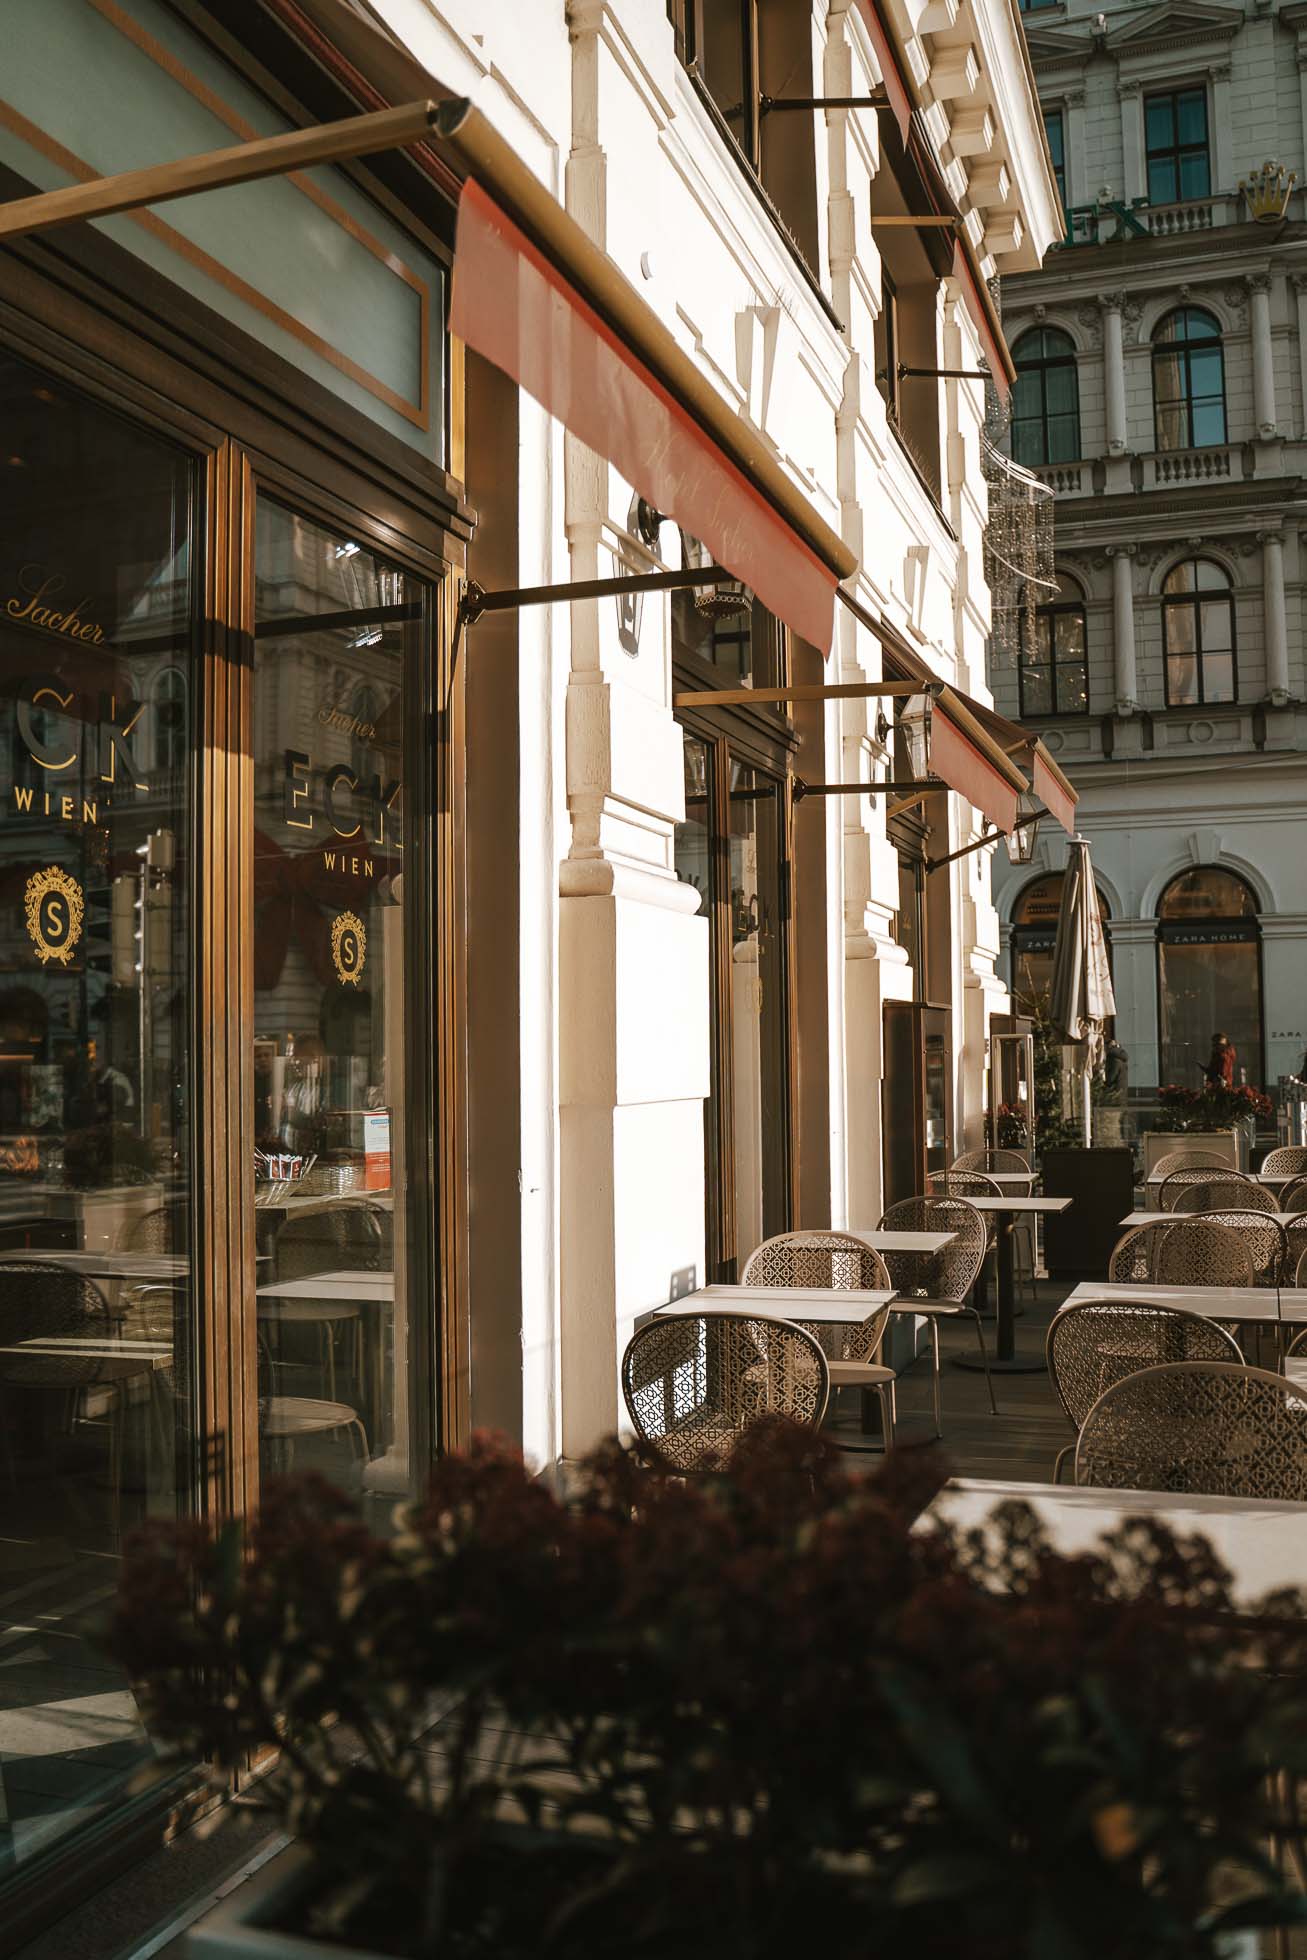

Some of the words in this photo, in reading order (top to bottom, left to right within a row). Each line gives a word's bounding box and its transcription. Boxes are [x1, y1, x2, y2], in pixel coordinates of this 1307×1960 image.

[7, 564, 105, 644] Sacher
[14, 786, 97, 824] WIEN
[284, 749, 404, 849] ECK
[324, 851, 374, 878] WIEN
[47, 901, 63, 937] S
[344, 937, 357, 966] S
[1173, 935, 1207, 943] ZARA
[1210, 933, 1246, 942] HOME
[1271, 1031, 1302, 1039] ZARA
